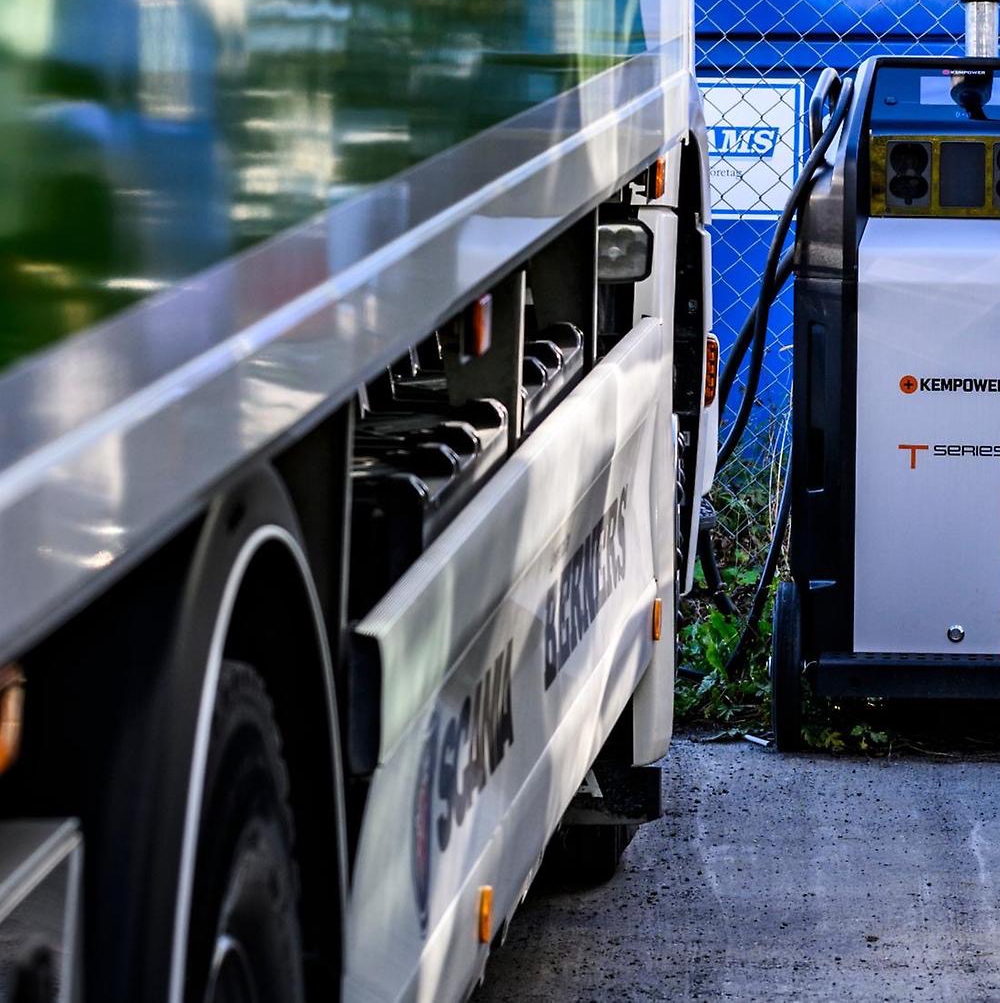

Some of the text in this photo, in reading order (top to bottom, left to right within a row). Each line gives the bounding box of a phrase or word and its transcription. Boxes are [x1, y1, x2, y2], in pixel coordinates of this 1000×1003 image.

[898, 444, 929, 470] T
[436, 483, 628, 853] SCANIA BERNERS
